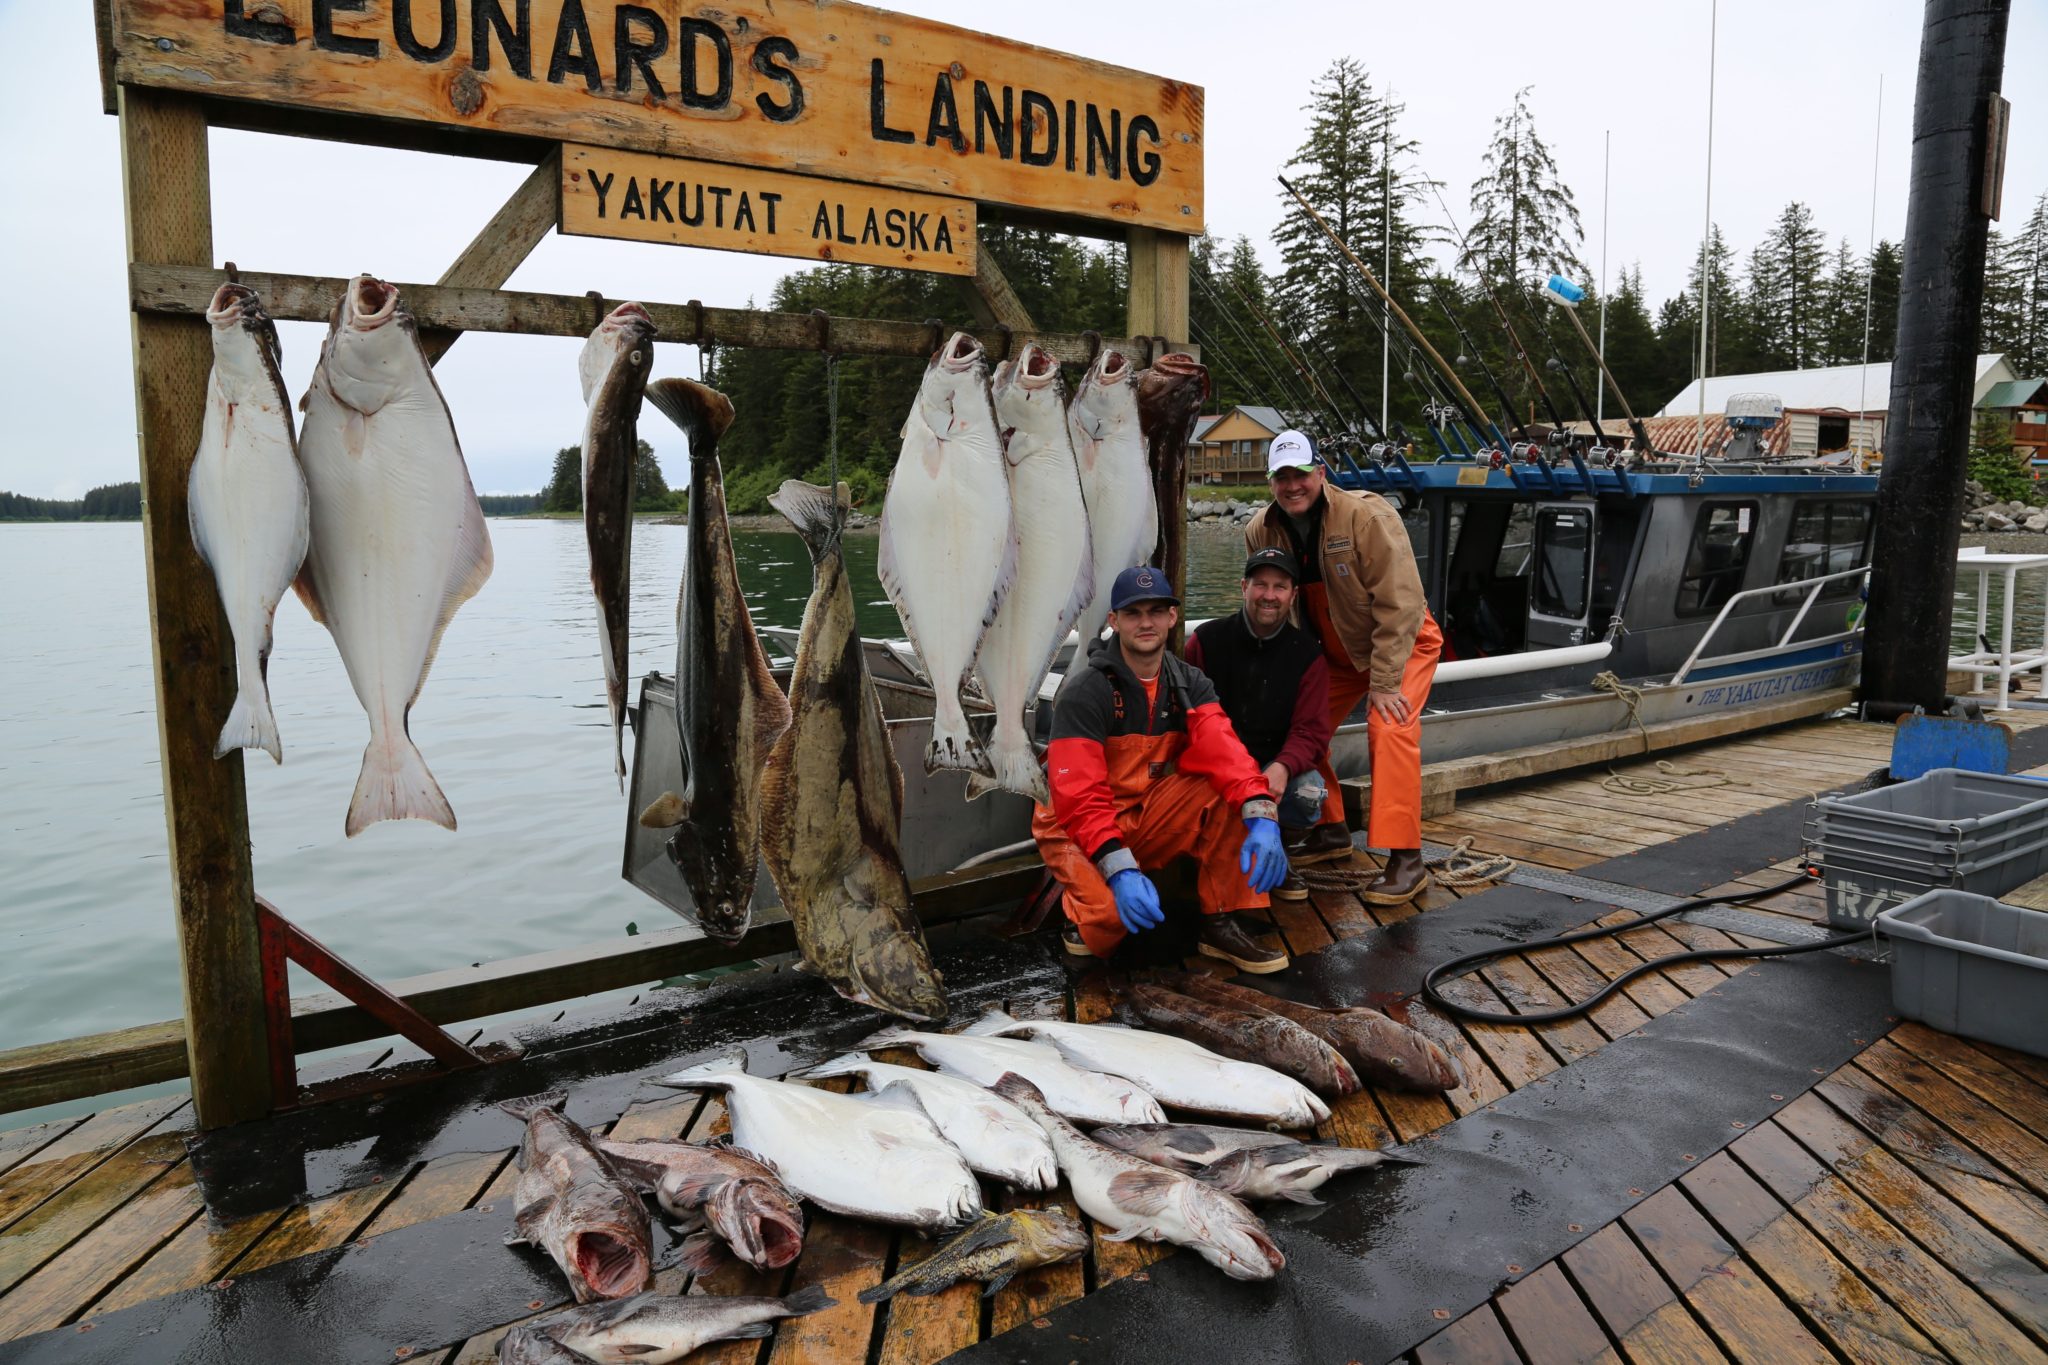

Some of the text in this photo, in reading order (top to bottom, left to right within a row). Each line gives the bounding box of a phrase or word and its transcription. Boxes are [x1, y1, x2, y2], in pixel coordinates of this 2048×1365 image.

[871, 58, 1163, 188] LANDING
[587, 168, 954, 255] YAKUTAT ALASKA
[1697, 687, 1726, 706] THE
[1723, 675, 1793, 706] YAKUTAT
